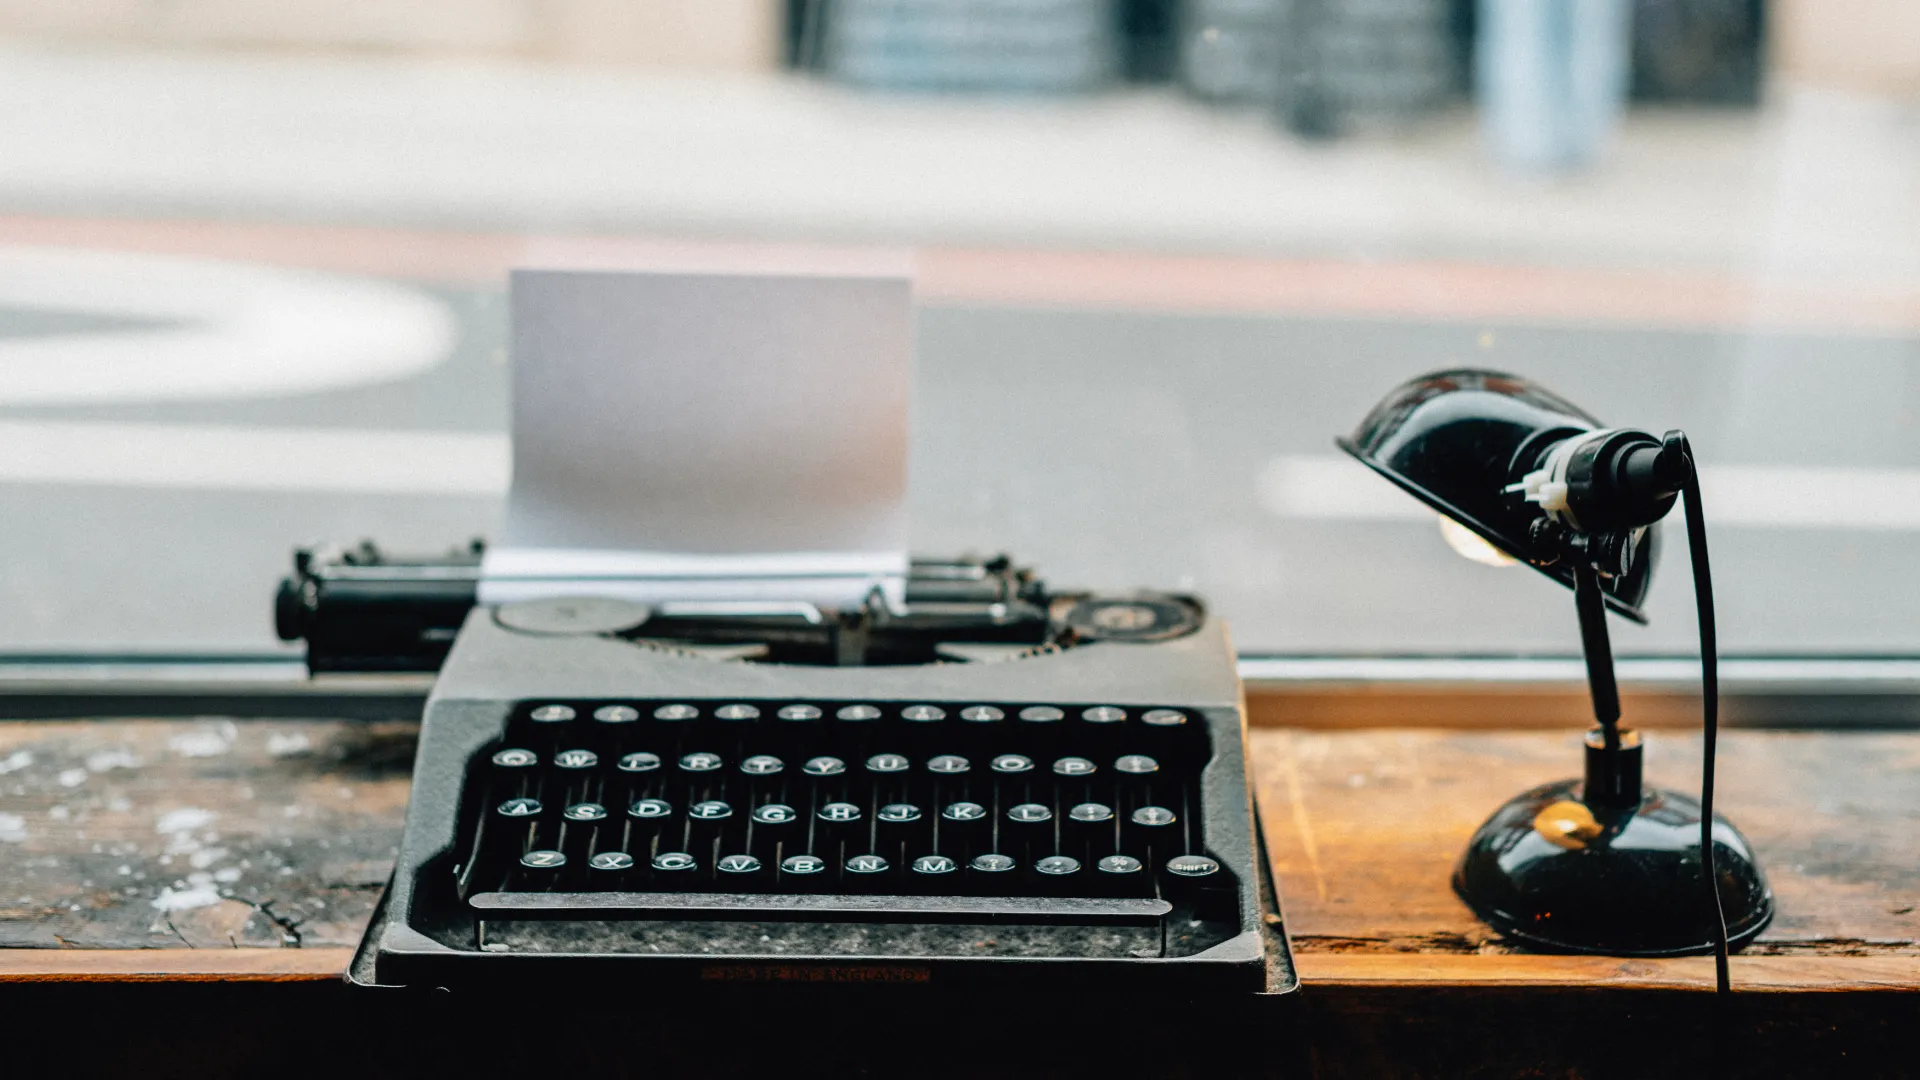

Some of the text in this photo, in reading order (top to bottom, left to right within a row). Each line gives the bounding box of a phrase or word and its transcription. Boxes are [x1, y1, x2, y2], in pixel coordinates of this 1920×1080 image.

[565, 754, 588, 766] W
[690, 757, 711, 769] R
[752, 760, 772, 771] T
[816, 762, 834, 773] Y
[878, 758, 898, 769] U
[1000, 758, 1025, 770] O
[1064, 762, 1086, 773] P
[511, 803, 529, 815] A
[576, 806, 595, 818] S
[638, 803, 661, 815] D
[701, 805, 720, 817] F
[762, 808, 786, 820] G
[831, 807, 850, 819] H
[889, 807, 908, 819] J
[954, 807, 973, 818] K
[532, 853, 554, 866] Z
[602, 856, 623, 868] X
[661, 856, 686, 868] C
[730, 859, 751, 871] V
[794, 860, 814, 871] B
[859, 859, 878, 870] N
[922, 860, 946, 871] M
[1175, 863, 1208, 872] SHIFT
